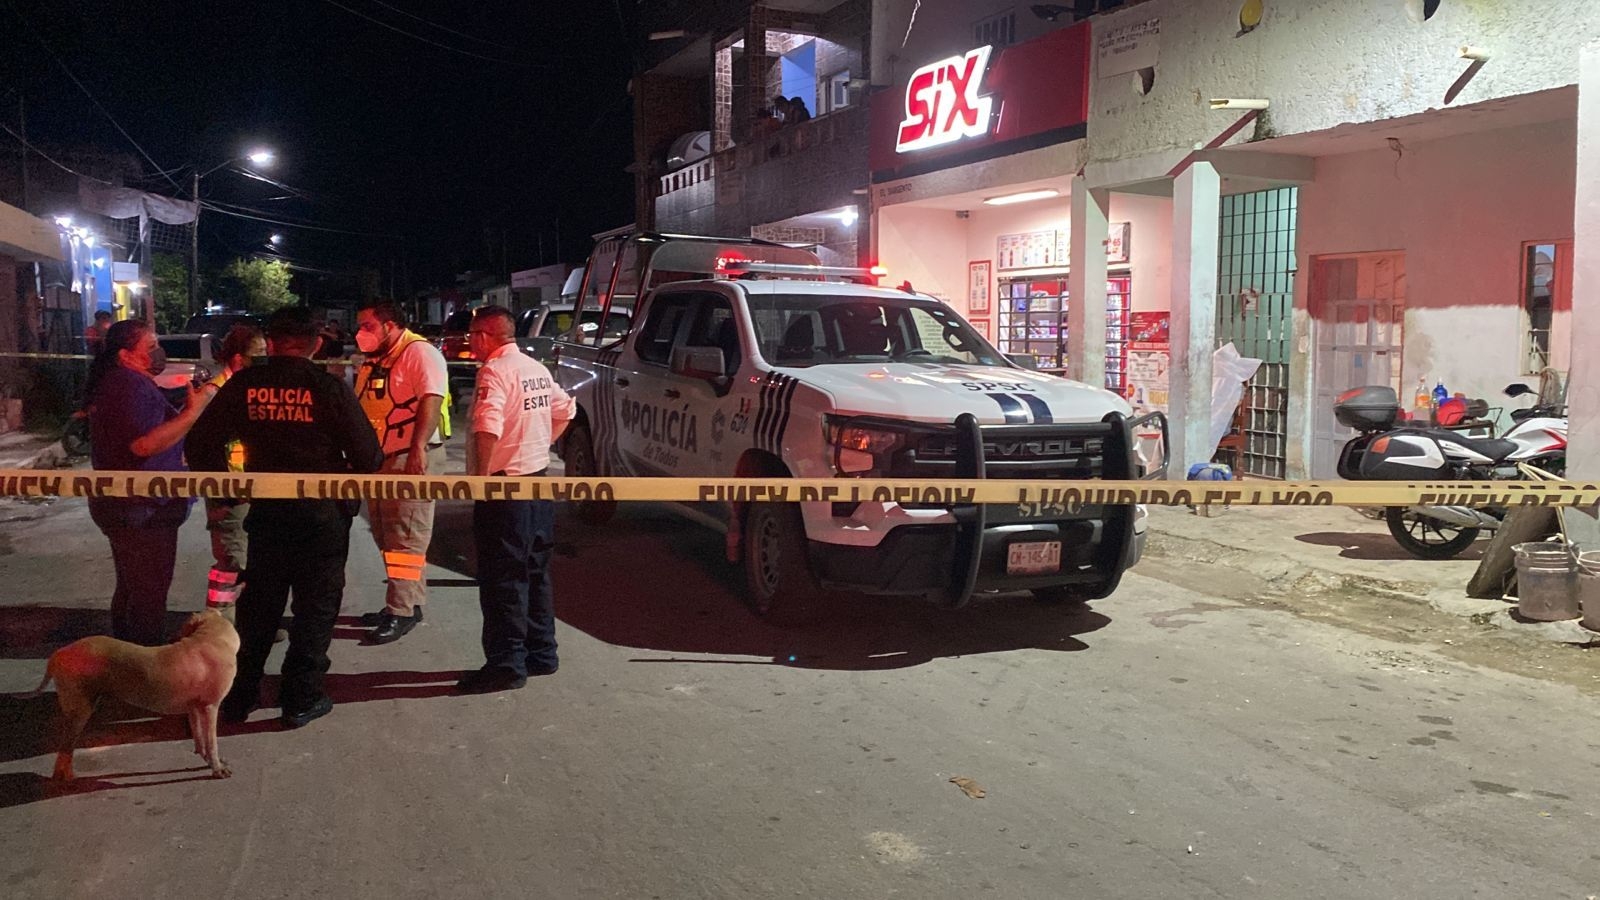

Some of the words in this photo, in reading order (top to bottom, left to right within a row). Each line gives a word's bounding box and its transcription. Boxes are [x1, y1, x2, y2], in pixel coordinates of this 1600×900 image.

[962, 382, 1036, 392] SPSC
[248, 405, 313, 422] ESTATAL
[632, 403, 698, 453] POLICÍA
